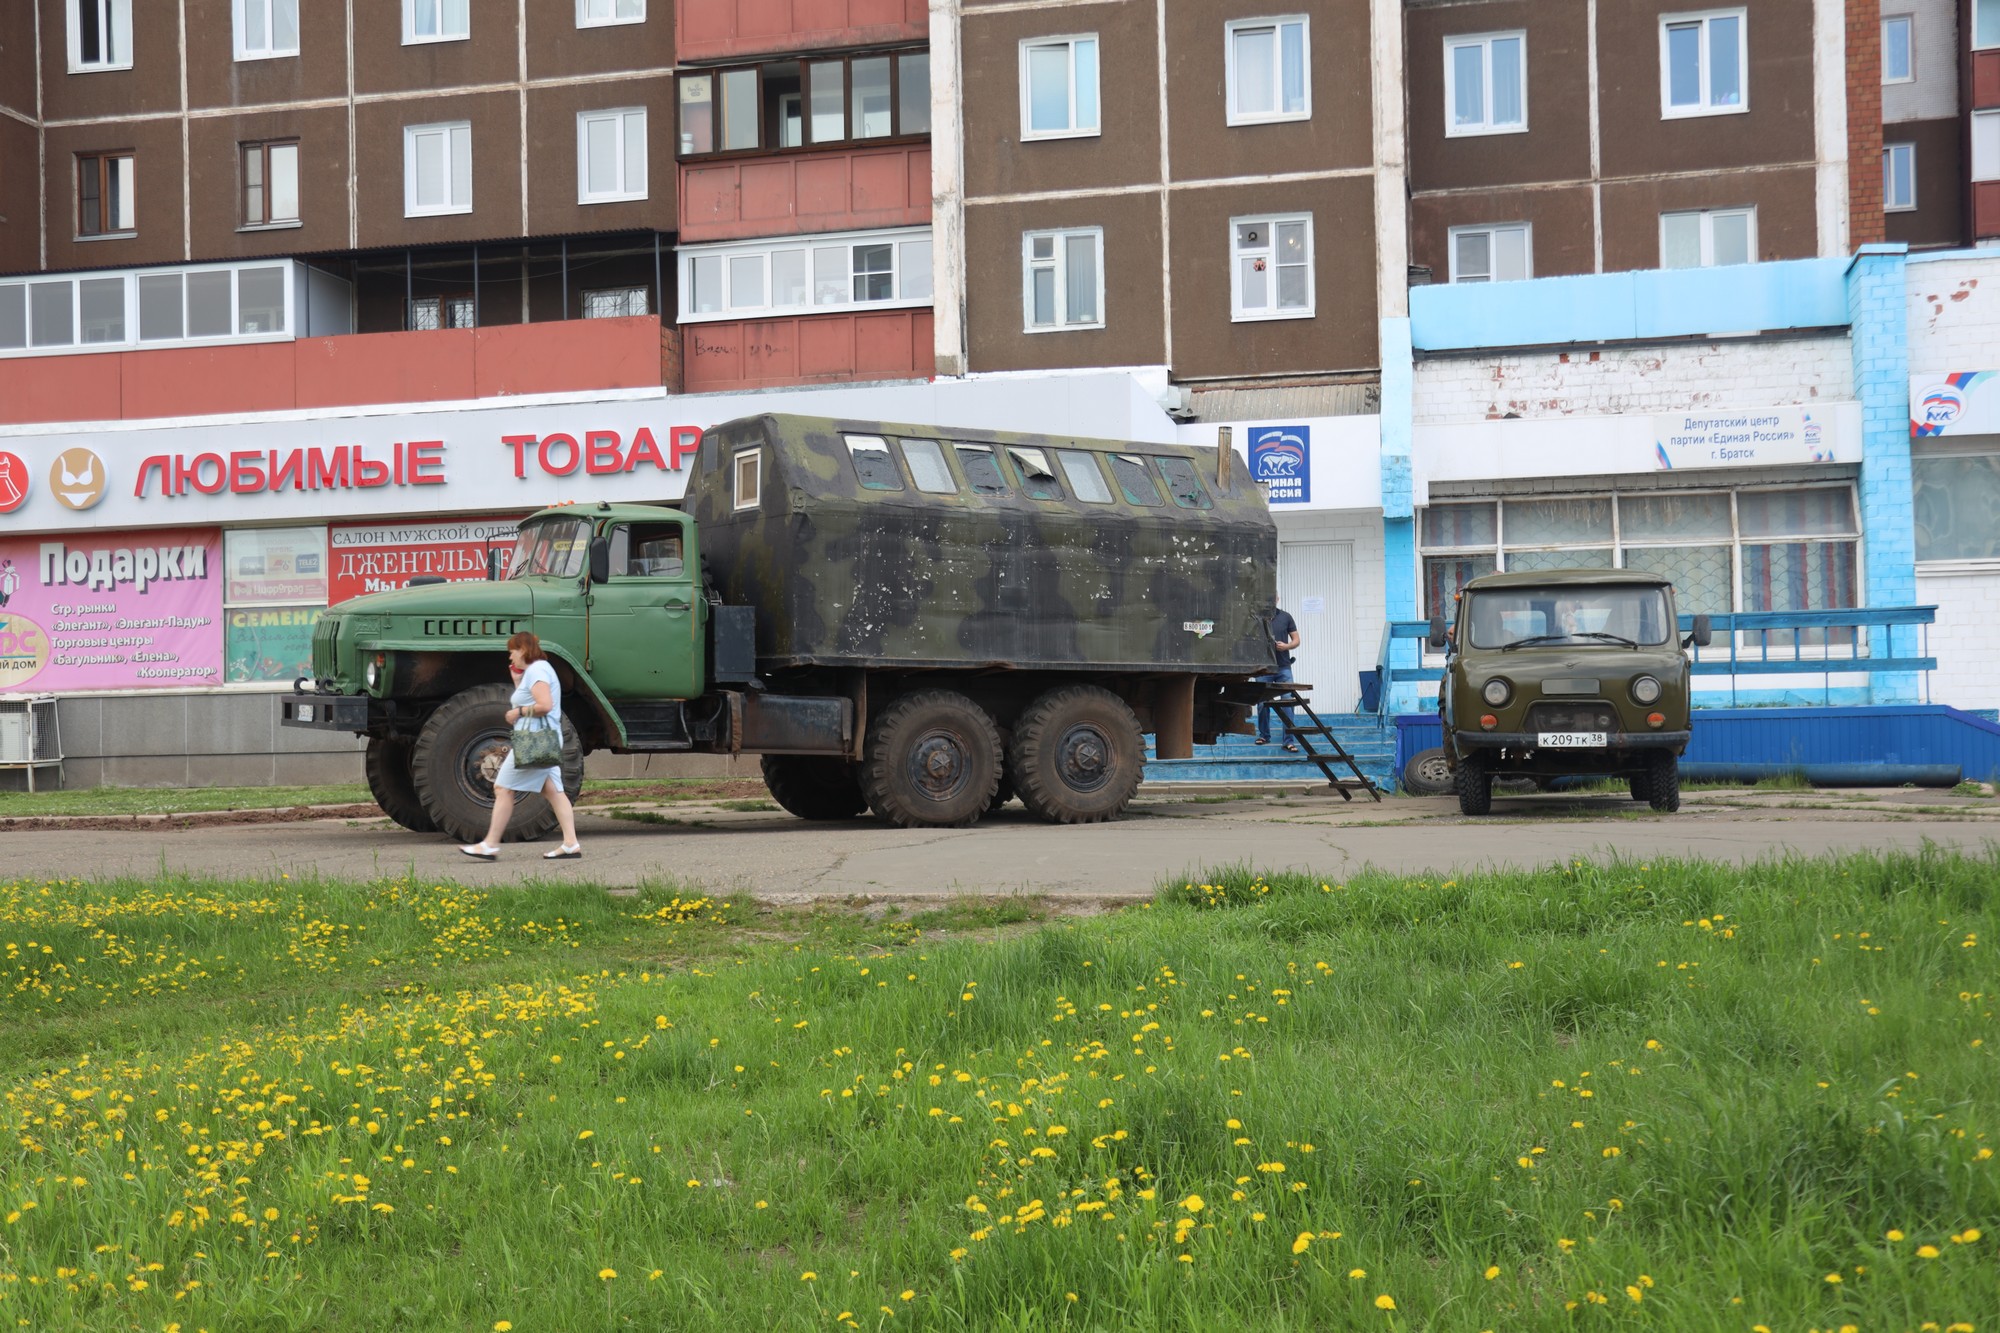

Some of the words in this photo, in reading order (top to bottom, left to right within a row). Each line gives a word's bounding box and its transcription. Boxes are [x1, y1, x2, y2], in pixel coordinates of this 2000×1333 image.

[1684, 416, 1748, 431] Депутатский
[1750, 416, 1780, 427] центр
[1670, 434, 1705, 447] партии
[1708, 433, 1750, 445] «Единая
[1753, 430, 1795, 442] Россия»
[134, 440, 446, 498] ЛЮБИМЫЕ
[501, 426, 704, 478] ТОВАР
[1711, 451, 1717, 459] г.
[1720, 448, 1755, 461] Братск
[332, 531, 385, 546] САЛОН
[389, 525, 470, 543] МУЖСКОЙ
[39, 543, 206, 592] Подарки
[51, 603, 75, 617] Стр.
[77, 603, 116, 617] рынки
[52, 620, 112, 632] «Элегант»,
[114, 615, 211, 631] «Элегант-Падун»
[52, 637, 108, 650] Торговые
[109, 635, 154, 649] центры
[52, 653, 128, 668] «Багульник»,
[130, 651, 179, 664] «Елена»,
[136, 665, 217, 680] «Кооператор»
[1591, 733, 1603, 742] 38
